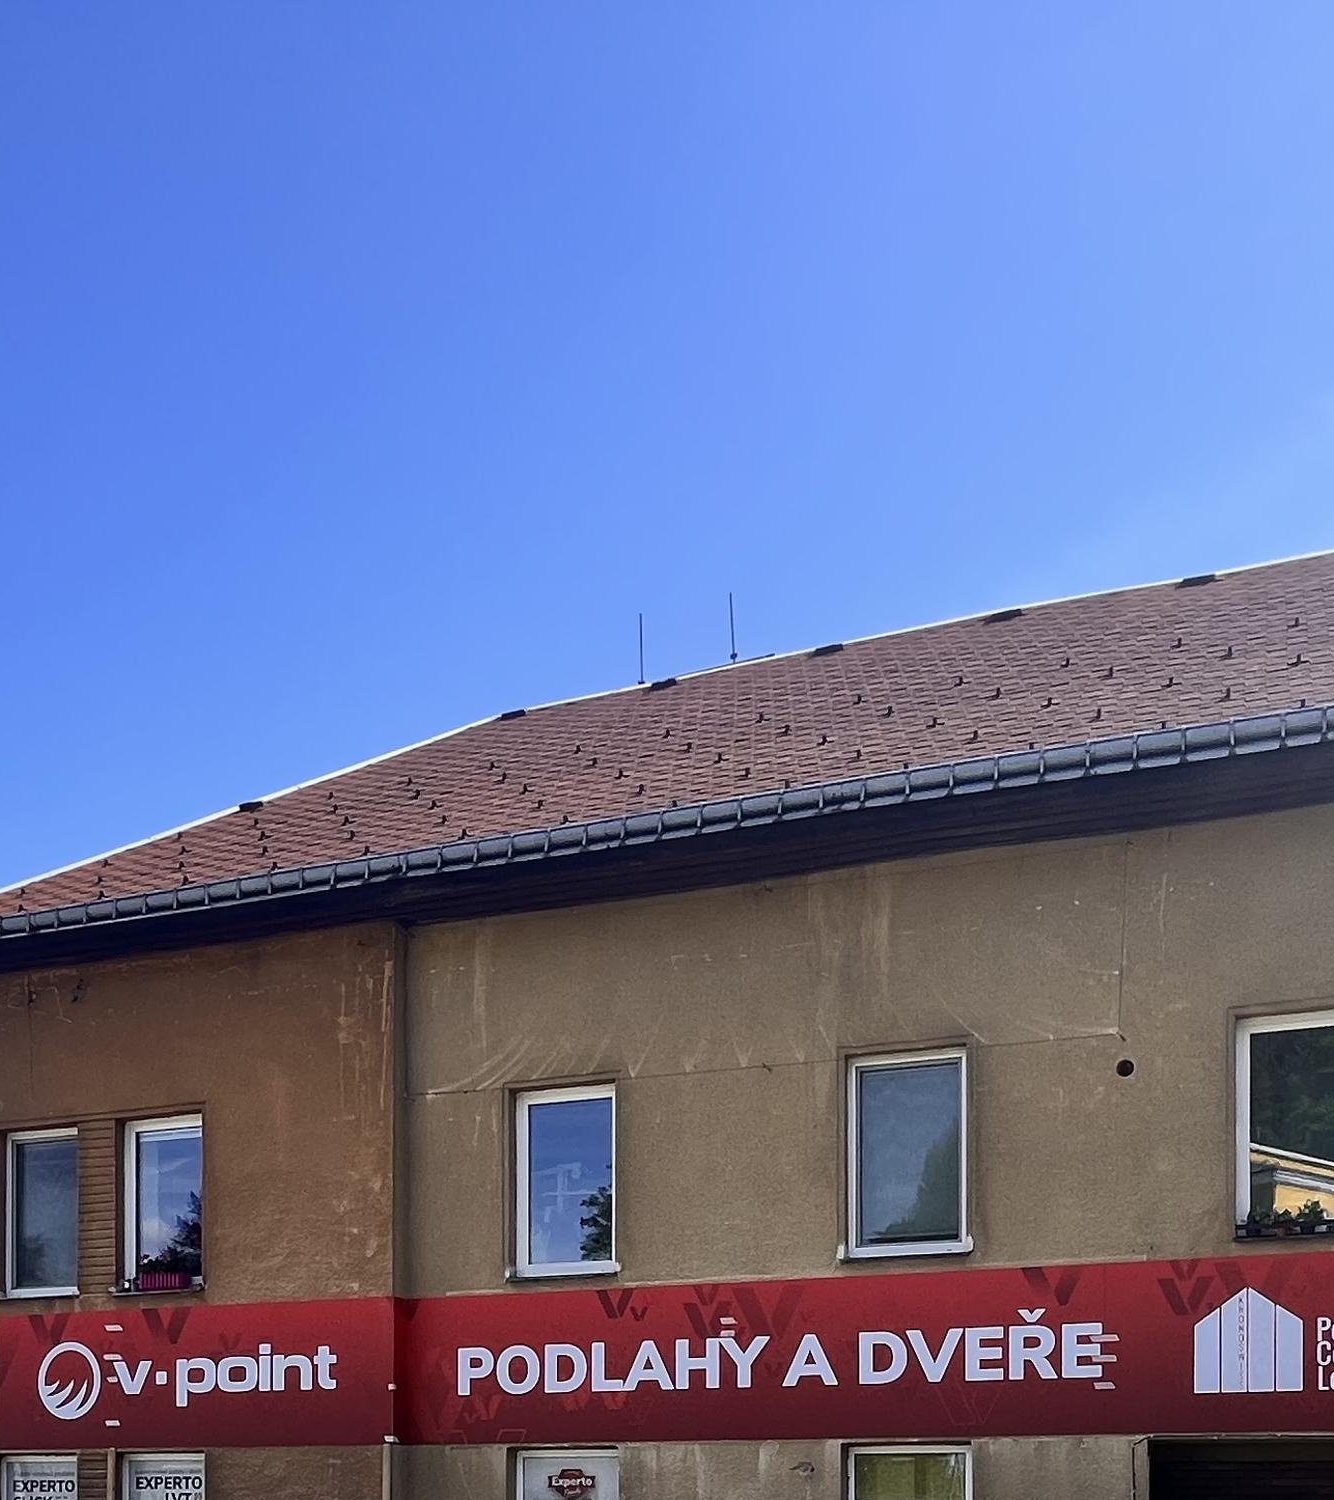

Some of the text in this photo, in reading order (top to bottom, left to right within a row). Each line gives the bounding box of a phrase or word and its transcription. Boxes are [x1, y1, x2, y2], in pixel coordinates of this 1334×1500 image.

[456, 1308, 1104, 1396] PODLAHY A DVEŘE
[13, 1479, 75, 1494] EXPERTO
[135, 1475, 203, 1490] EXPERTO
[551, 1475, 593, 1489] Experto
